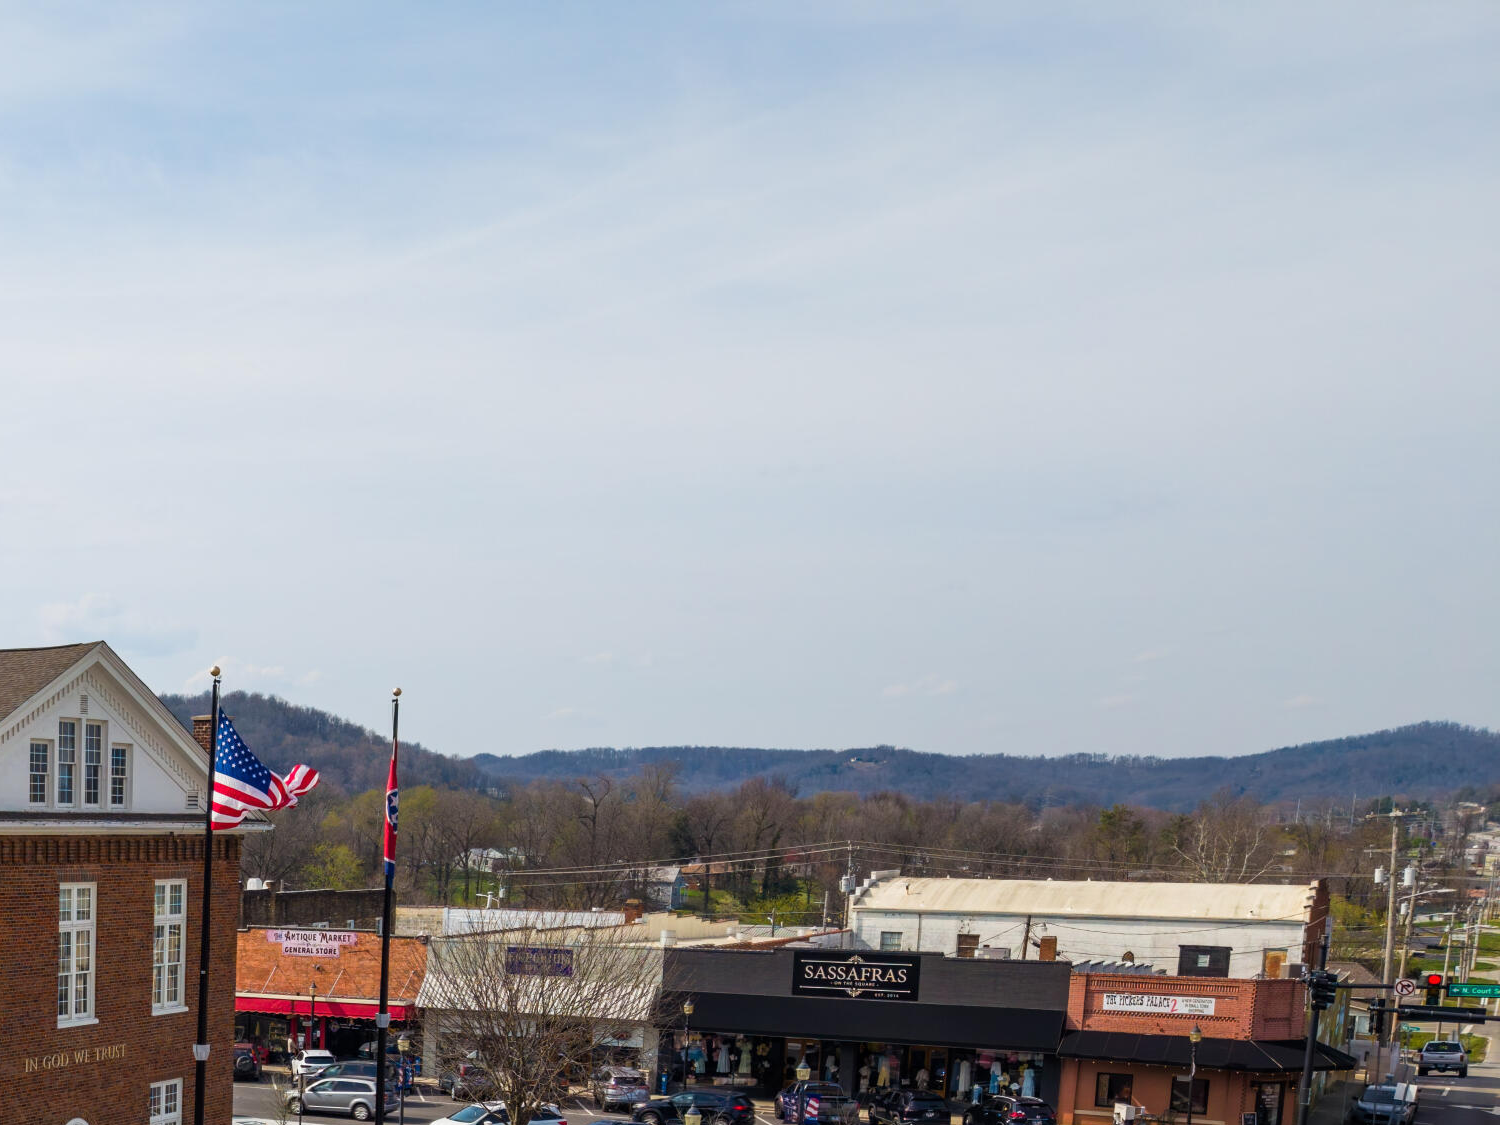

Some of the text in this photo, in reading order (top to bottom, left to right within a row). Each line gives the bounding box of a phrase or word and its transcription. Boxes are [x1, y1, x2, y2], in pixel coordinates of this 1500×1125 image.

[284, 930, 317, 942] ANTIQUE
[318, 932, 351, 943] MARKET
[284, 946, 314, 954] GENERAL
[804, 965, 907, 983] SASSAFRAS
[1105, 994, 1179, 1013] THE PICKERS PALACE 2
[25, 1044, 126, 1073] IN GOD WE TRUST
